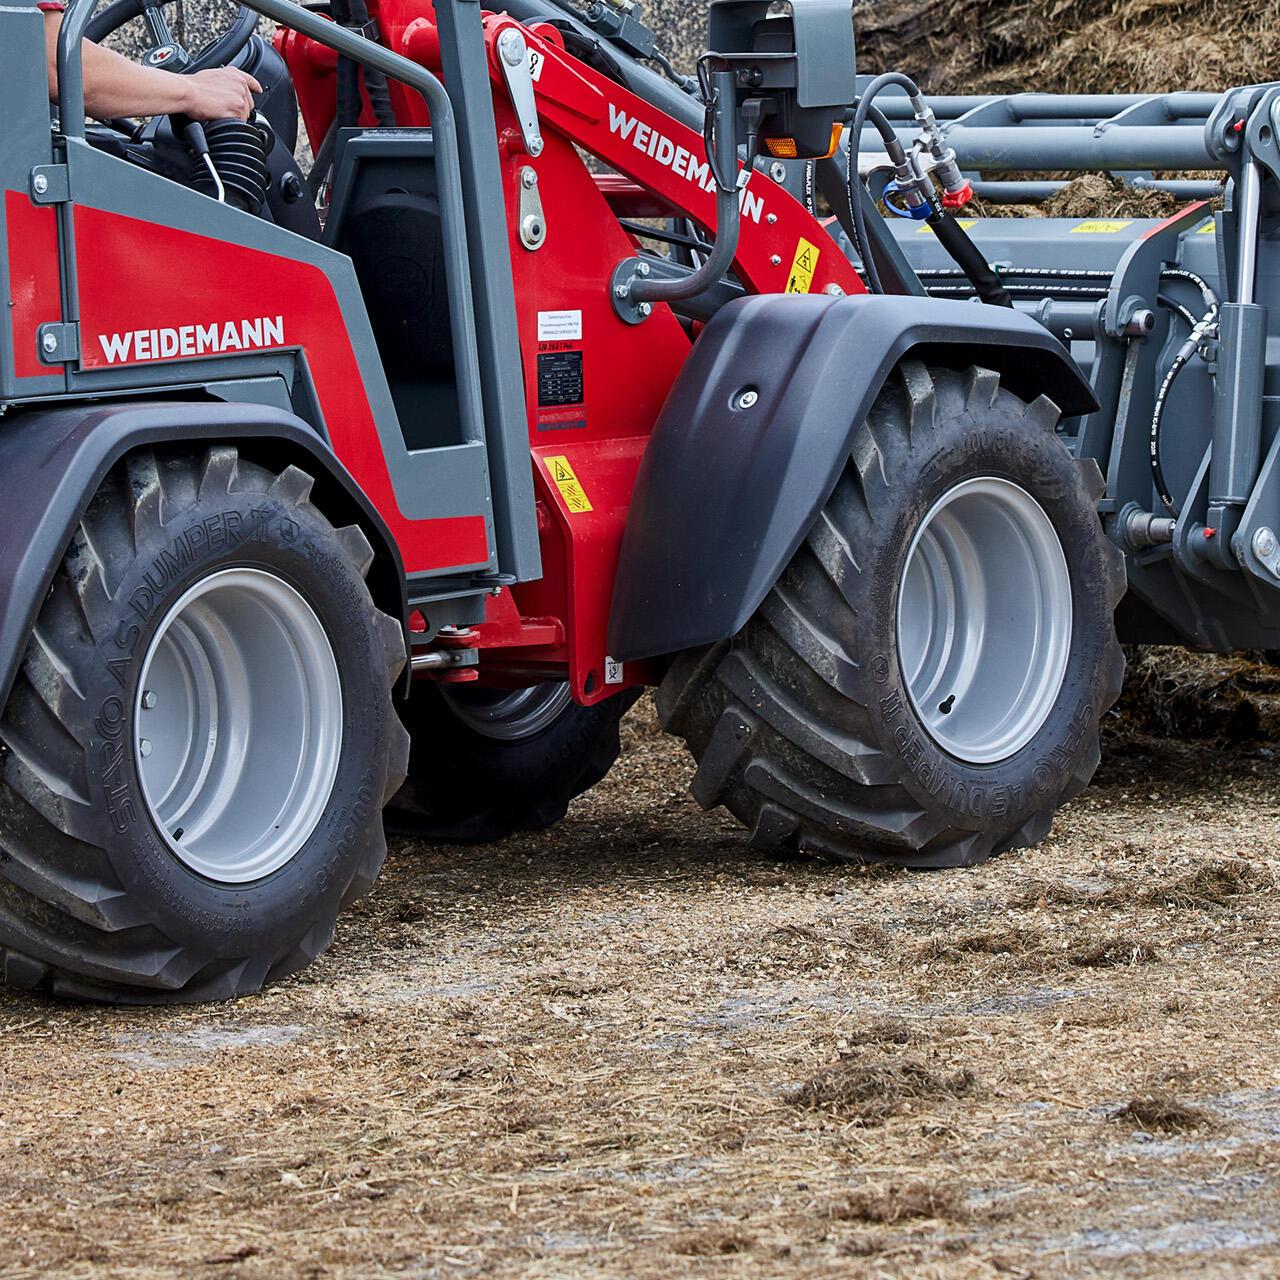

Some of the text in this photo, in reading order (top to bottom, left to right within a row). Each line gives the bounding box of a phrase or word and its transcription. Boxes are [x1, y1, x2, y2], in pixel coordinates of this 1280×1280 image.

[609, 102, 765, 225] WEIDEMN
[98, 316, 285, 363] WEIDEMANN
[107, 624, 142, 687] AS
[128, 510, 245, 620] DUMPER
[893, 724, 987, 818] DUMPER
[990, 783, 1024, 817] AS
